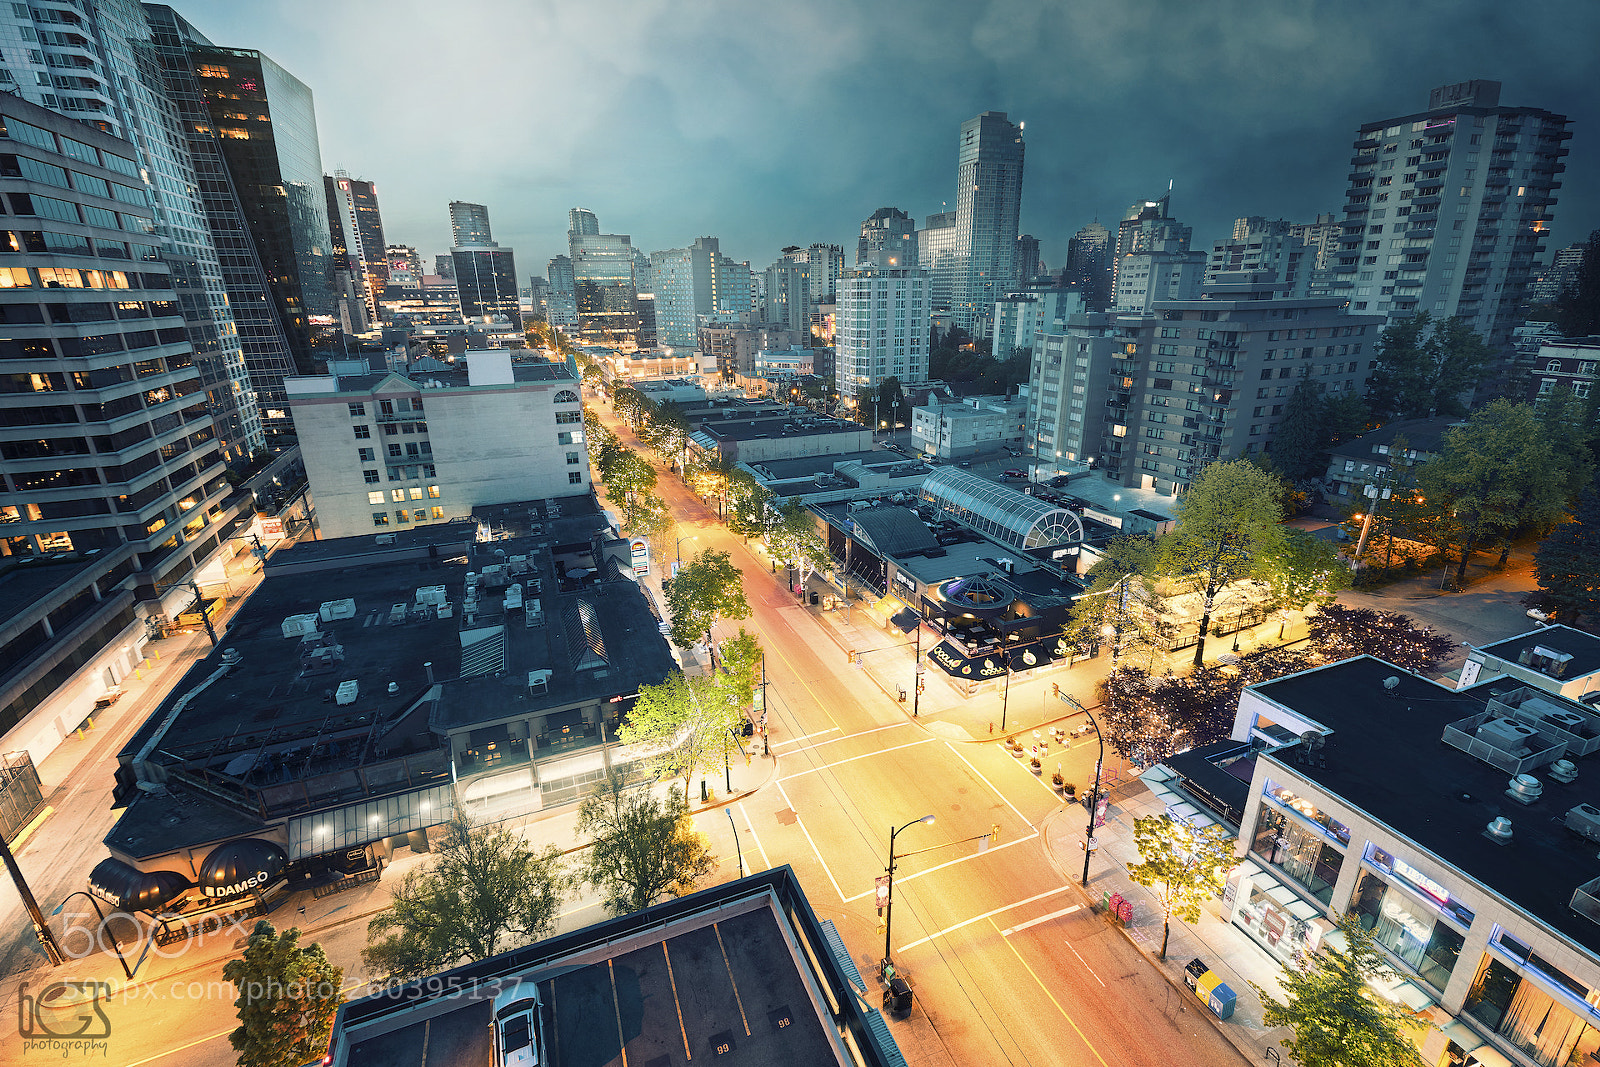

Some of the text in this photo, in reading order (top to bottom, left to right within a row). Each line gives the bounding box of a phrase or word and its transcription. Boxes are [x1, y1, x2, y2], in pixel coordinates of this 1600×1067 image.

[216, 871, 269, 898] DAMSO
[778, 1017, 791, 1029] 98
[716, 1043, 730, 1055] 99
